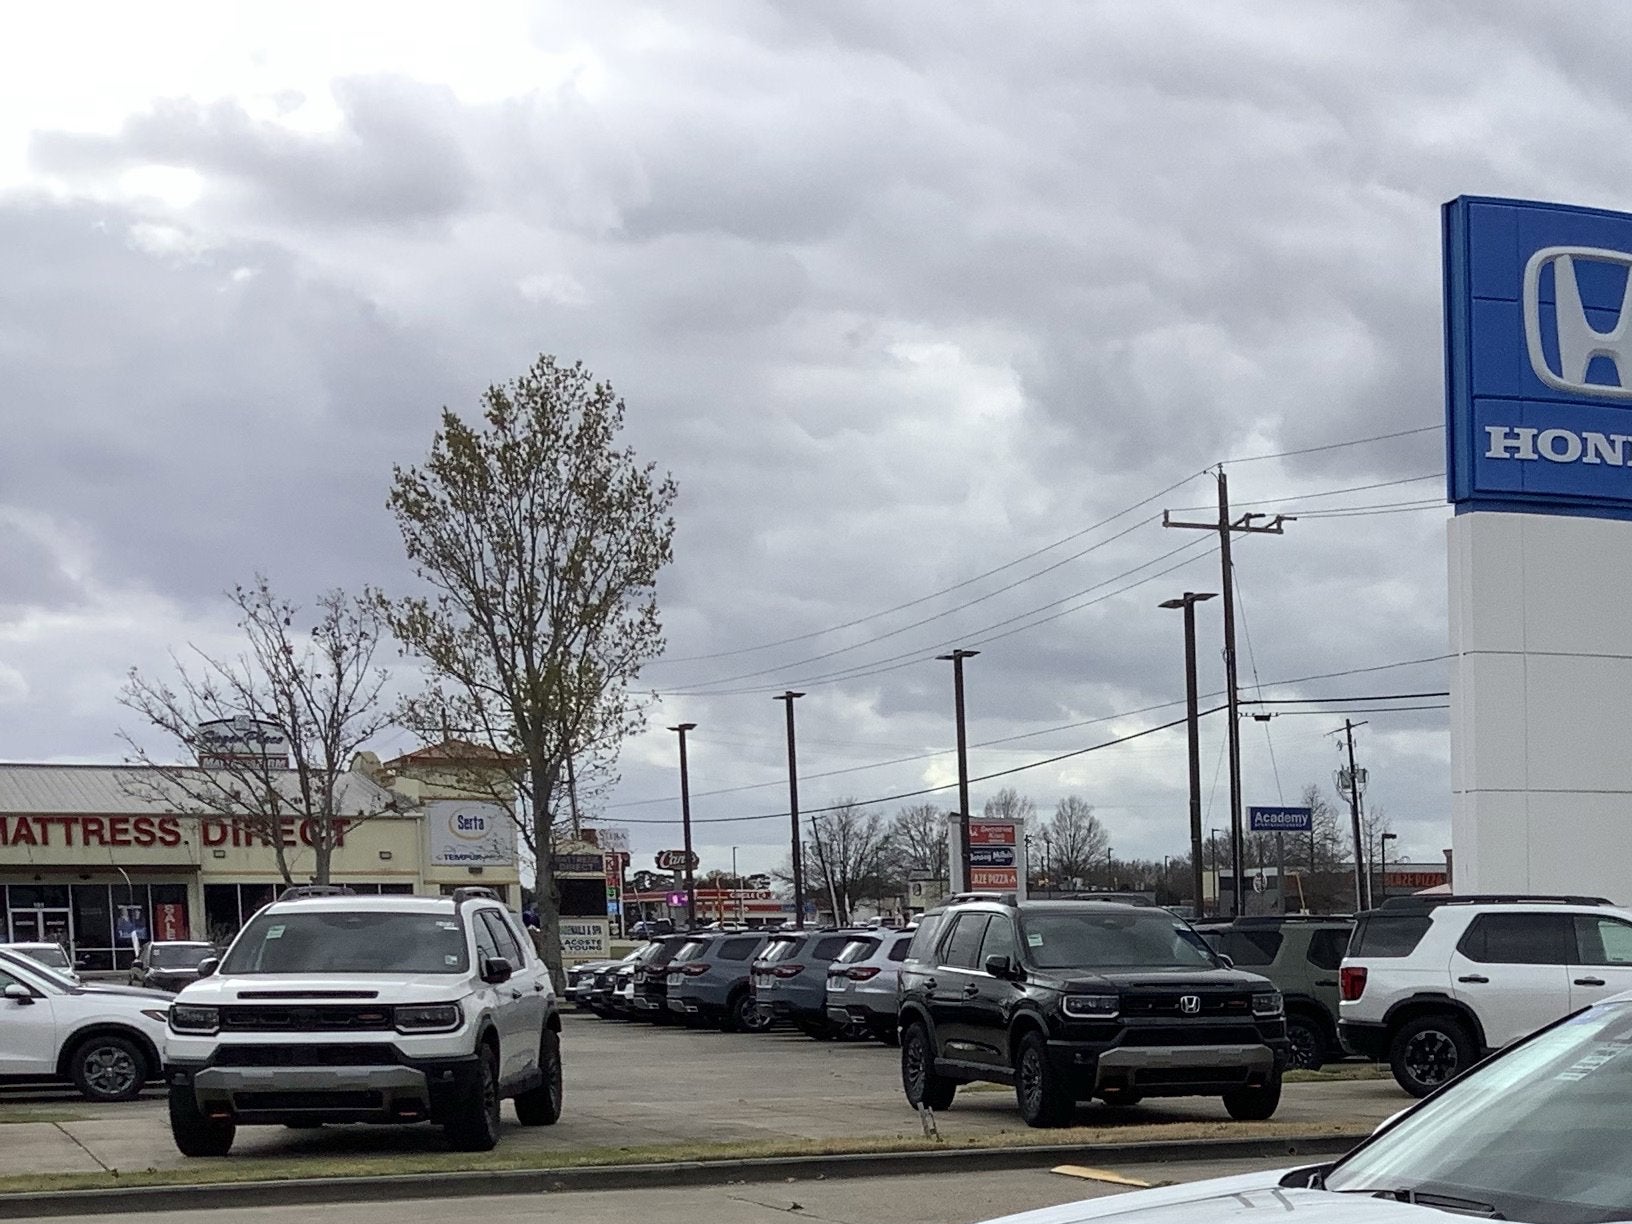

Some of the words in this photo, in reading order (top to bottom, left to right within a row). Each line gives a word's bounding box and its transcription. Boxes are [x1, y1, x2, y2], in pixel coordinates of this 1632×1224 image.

[457, 815, 485, 830] Serta
[1254, 811, 1308, 826] Academy
[659, 852, 697, 868] Cans
[988, 873, 1009, 884] PIZZA
[163, 904, 176, 940] SALE
